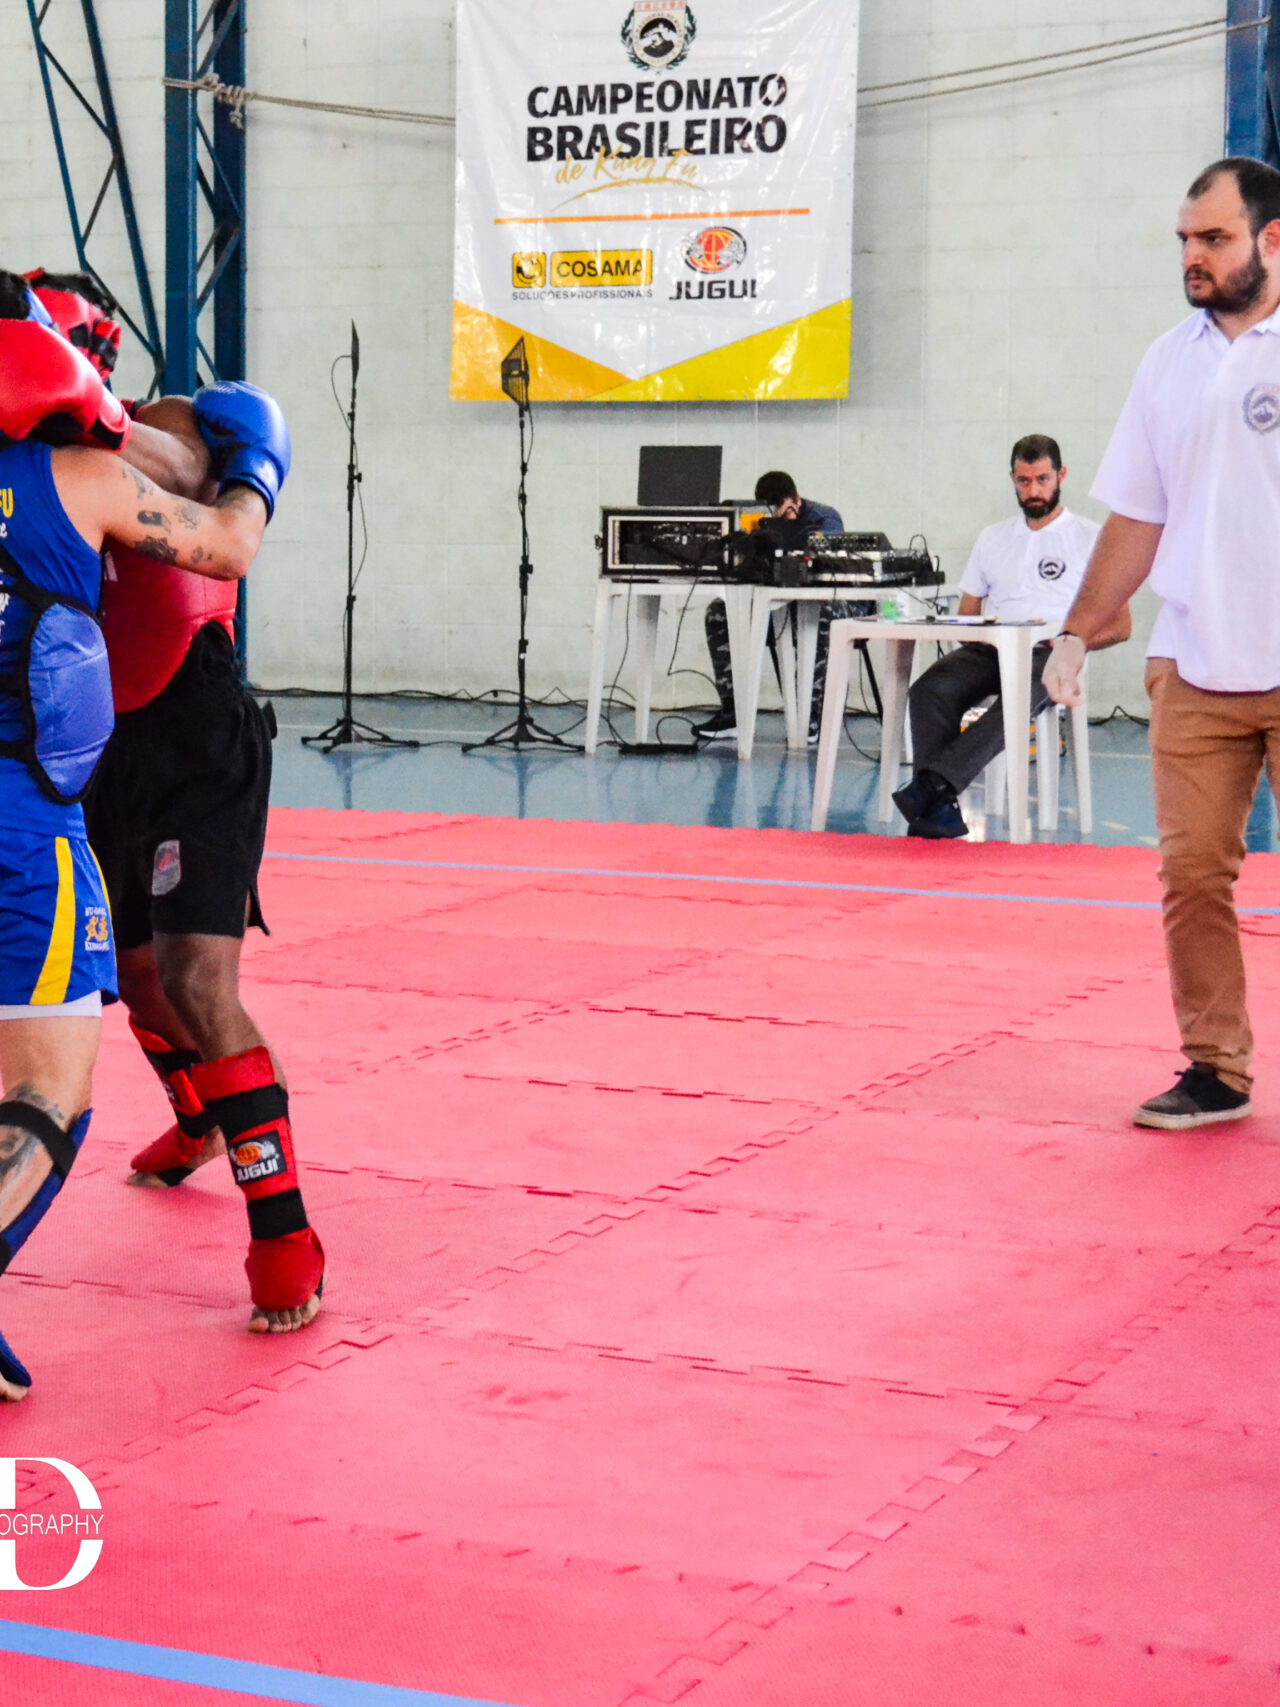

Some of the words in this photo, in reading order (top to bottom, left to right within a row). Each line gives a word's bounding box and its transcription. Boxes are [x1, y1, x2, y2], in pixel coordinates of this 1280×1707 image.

[527, 73, 787, 118] CAMPEONATO
[526, 115, 787, 162] BRASILEIRO
[556, 156, 585, 184] de
[593, 146, 656, 180] Kung
[664, 149, 697, 178] Fu
[557, 261, 643, 278] COSAMA
[570, 288, 653, 300] PROFISSIONAS
[669, 279, 757, 300] JUGUI
